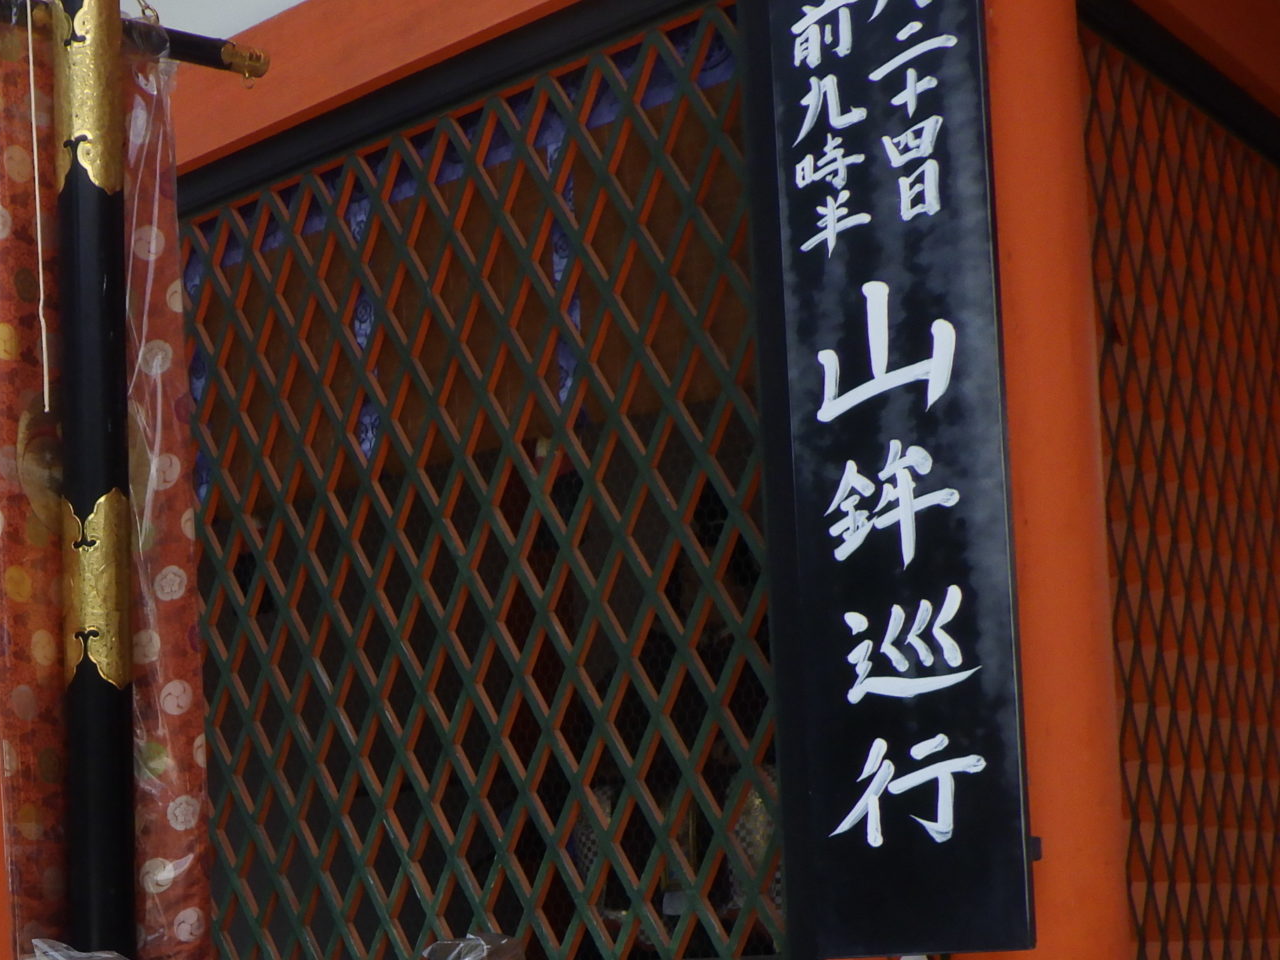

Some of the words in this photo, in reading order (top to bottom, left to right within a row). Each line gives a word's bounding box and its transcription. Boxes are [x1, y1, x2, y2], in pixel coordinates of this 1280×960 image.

[792, 0, 871, 258] 前九時半
[867, 0, 958, 222] 二十四日
[817, 280, 986, 847] 山鉾巡行
